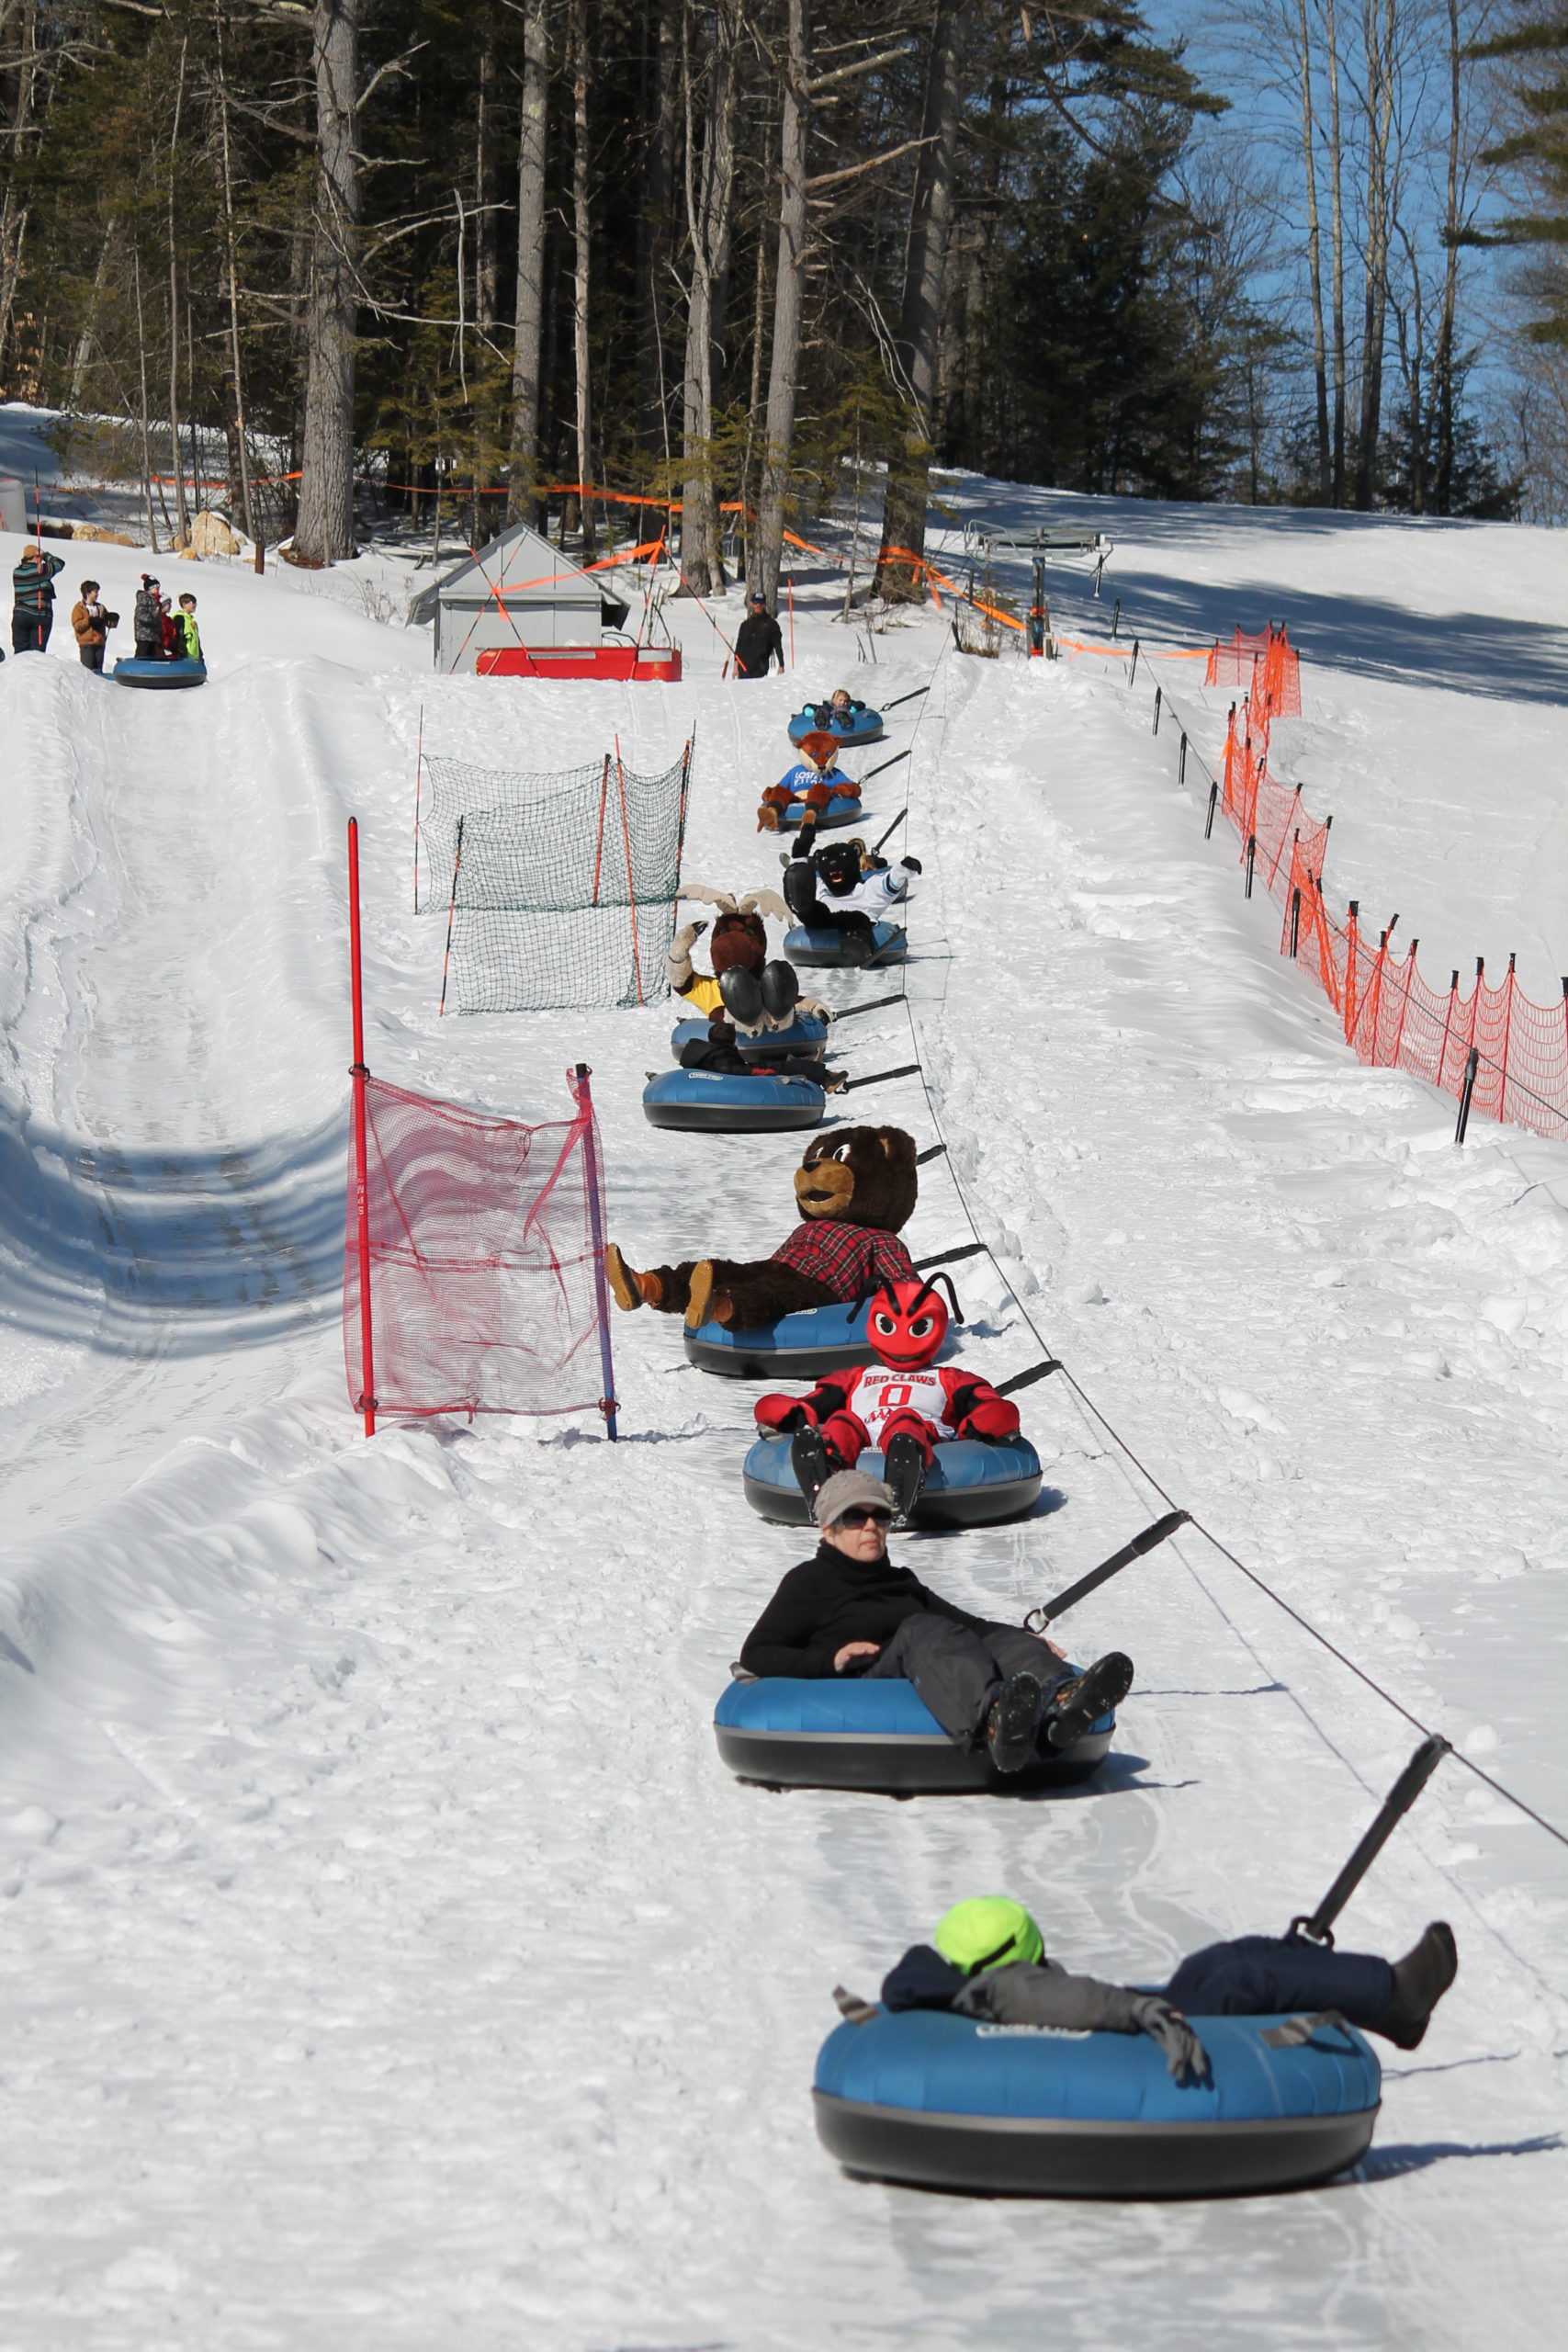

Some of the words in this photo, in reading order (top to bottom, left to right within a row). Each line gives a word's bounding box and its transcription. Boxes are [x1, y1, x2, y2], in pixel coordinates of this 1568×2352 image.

[795, 771, 815, 780] LOST
[864, 1375, 889, 1387] RED
[891, 1374, 937, 1386] CLAWS
[878, 1384, 913, 1408] 0
